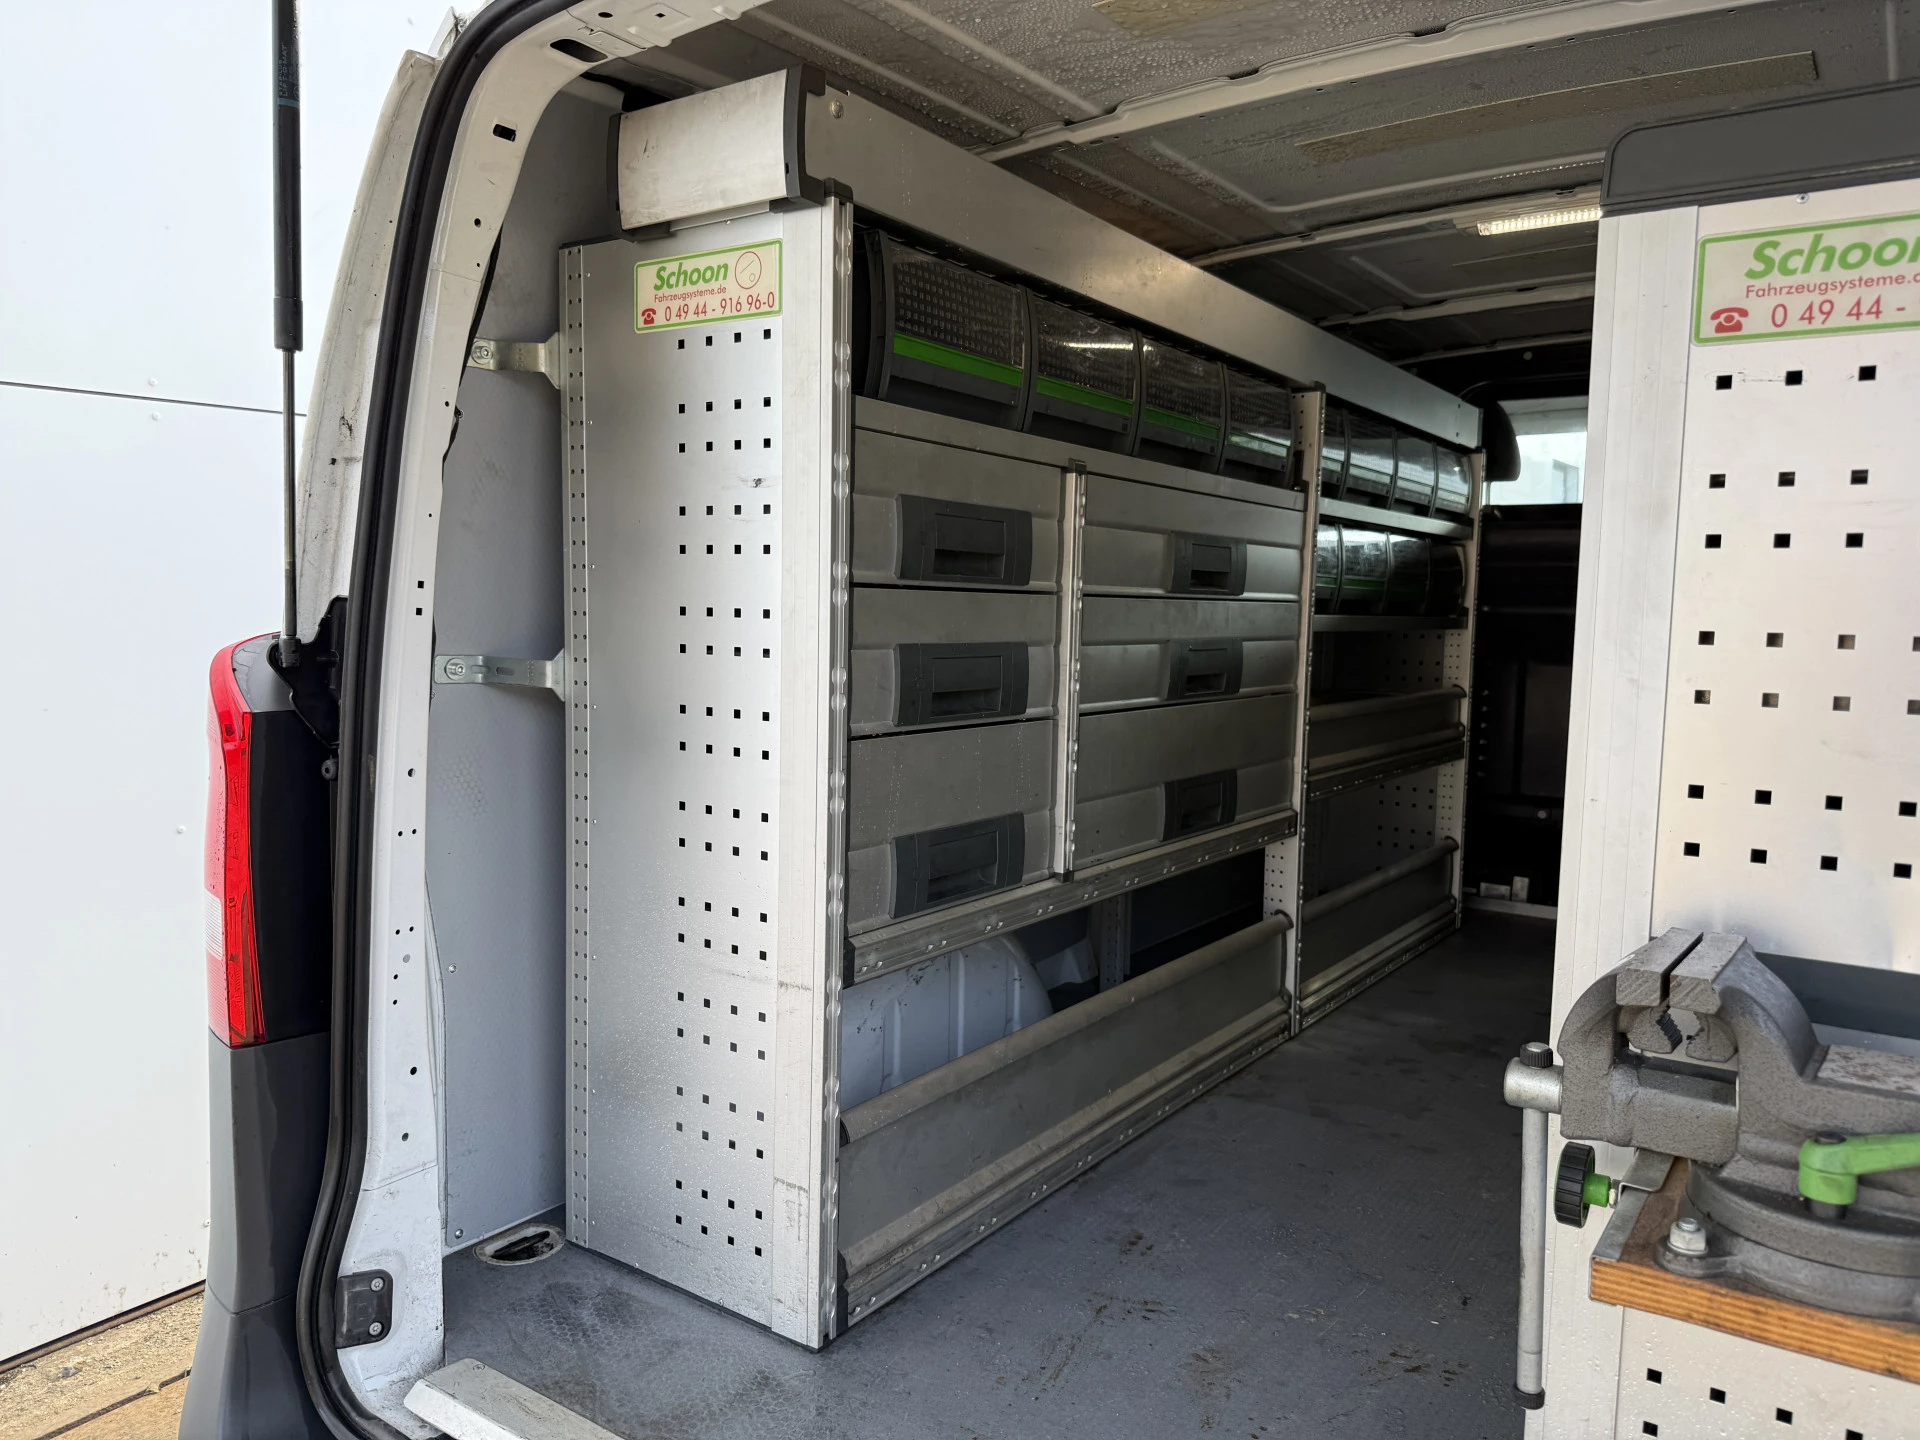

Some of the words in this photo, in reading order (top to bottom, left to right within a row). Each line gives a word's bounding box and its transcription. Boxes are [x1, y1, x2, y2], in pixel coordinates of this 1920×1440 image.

[653, 262, 729, 291] Schoon
[654, 284, 727, 303] Fahrzeugsysteme.de
[664, 306, 672, 322] 0
[675, 304, 689, 321] 49
[693, 301, 707, 317] 44
[720, 296, 742, 315] 916
[746, 291, 775, 311] 96-0
[1771, 303, 1788, 328] 0
[1798, 299, 1835, 325] 49
[1845, 294, 1883, 321] 44
